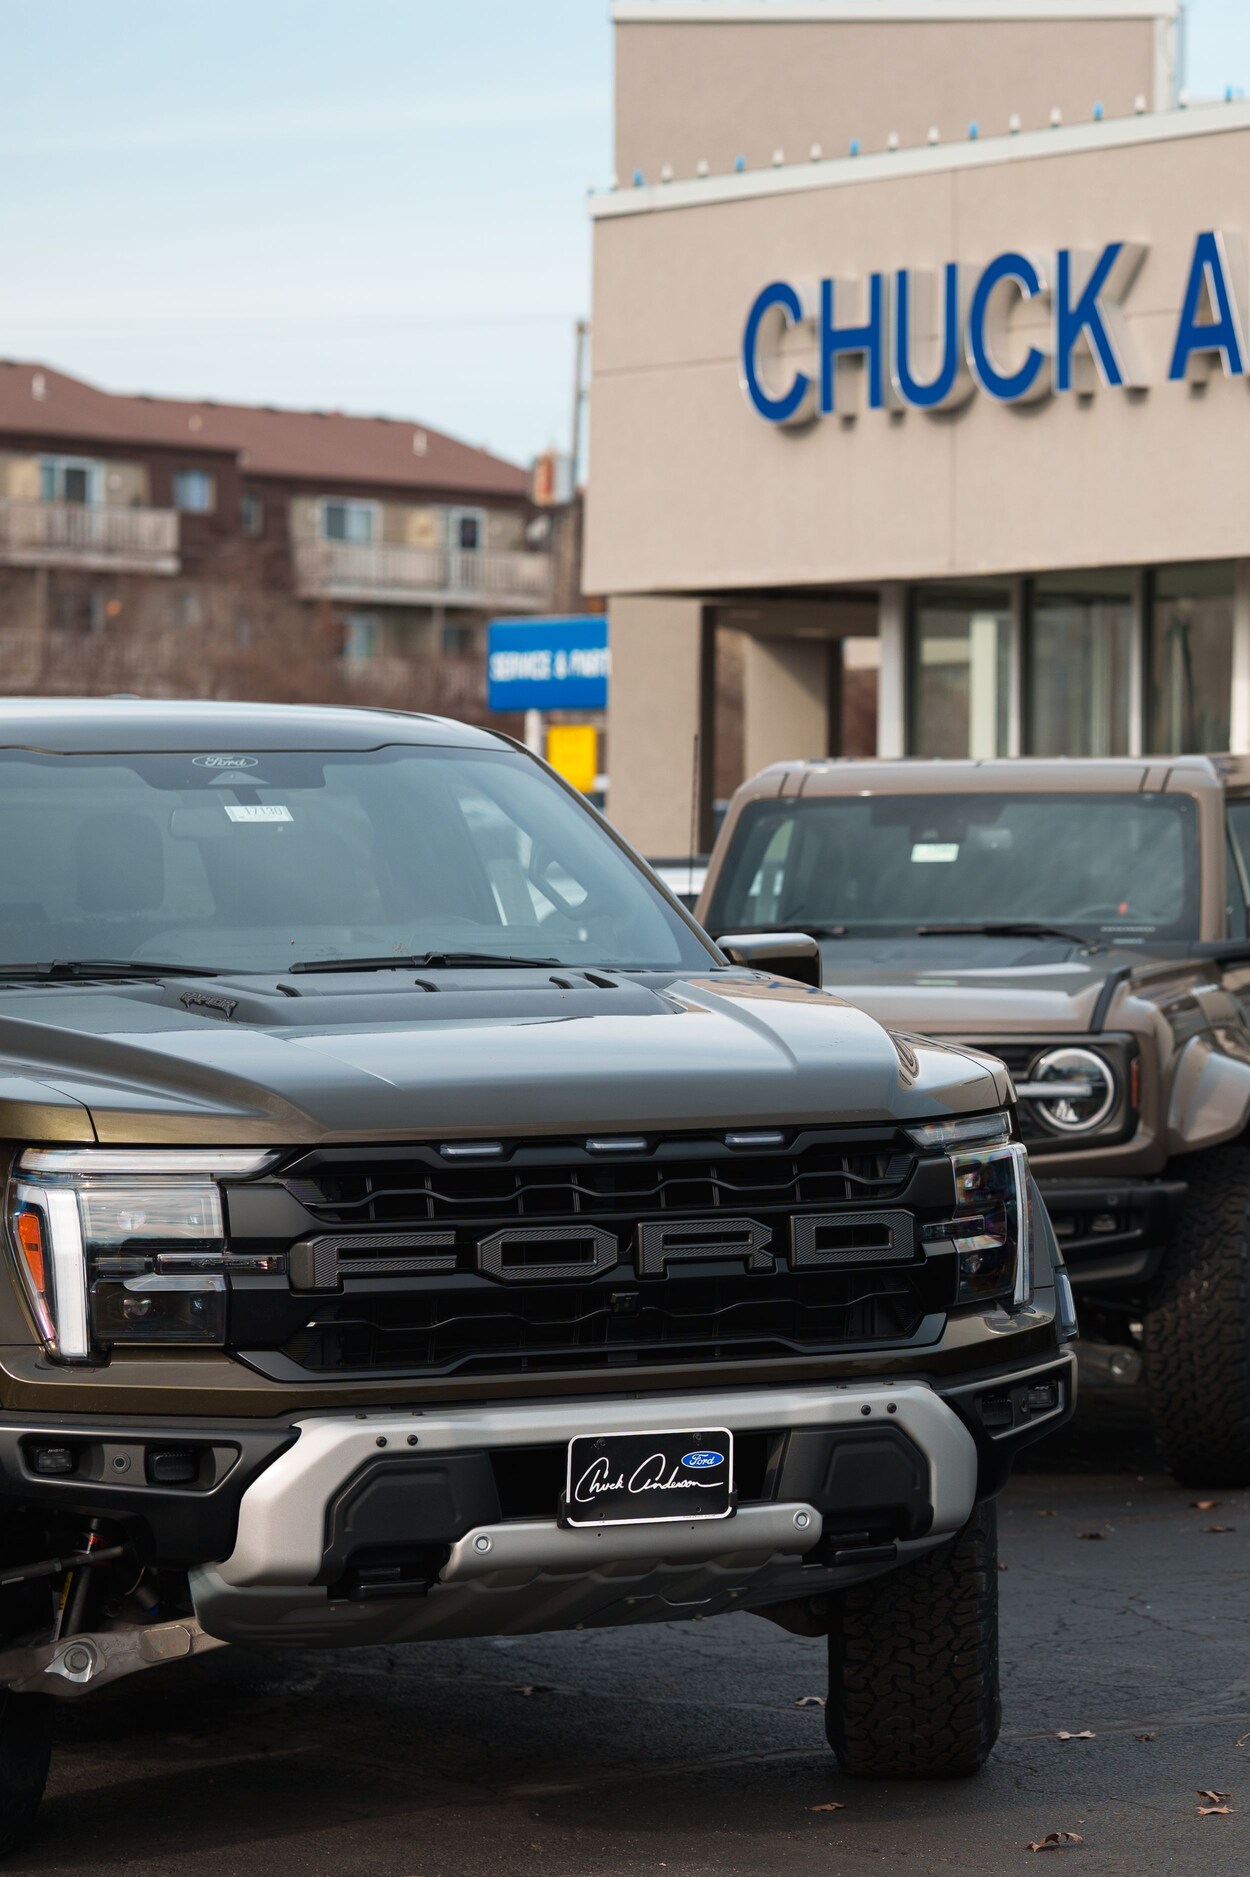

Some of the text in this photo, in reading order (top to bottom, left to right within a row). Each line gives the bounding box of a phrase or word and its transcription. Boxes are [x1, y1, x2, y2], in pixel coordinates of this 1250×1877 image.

[740, 241, 1130, 424] CHUCK
[300, 1209, 915, 1288] FORD
[574, 1453, 724, 1503] Chuck Anderson
